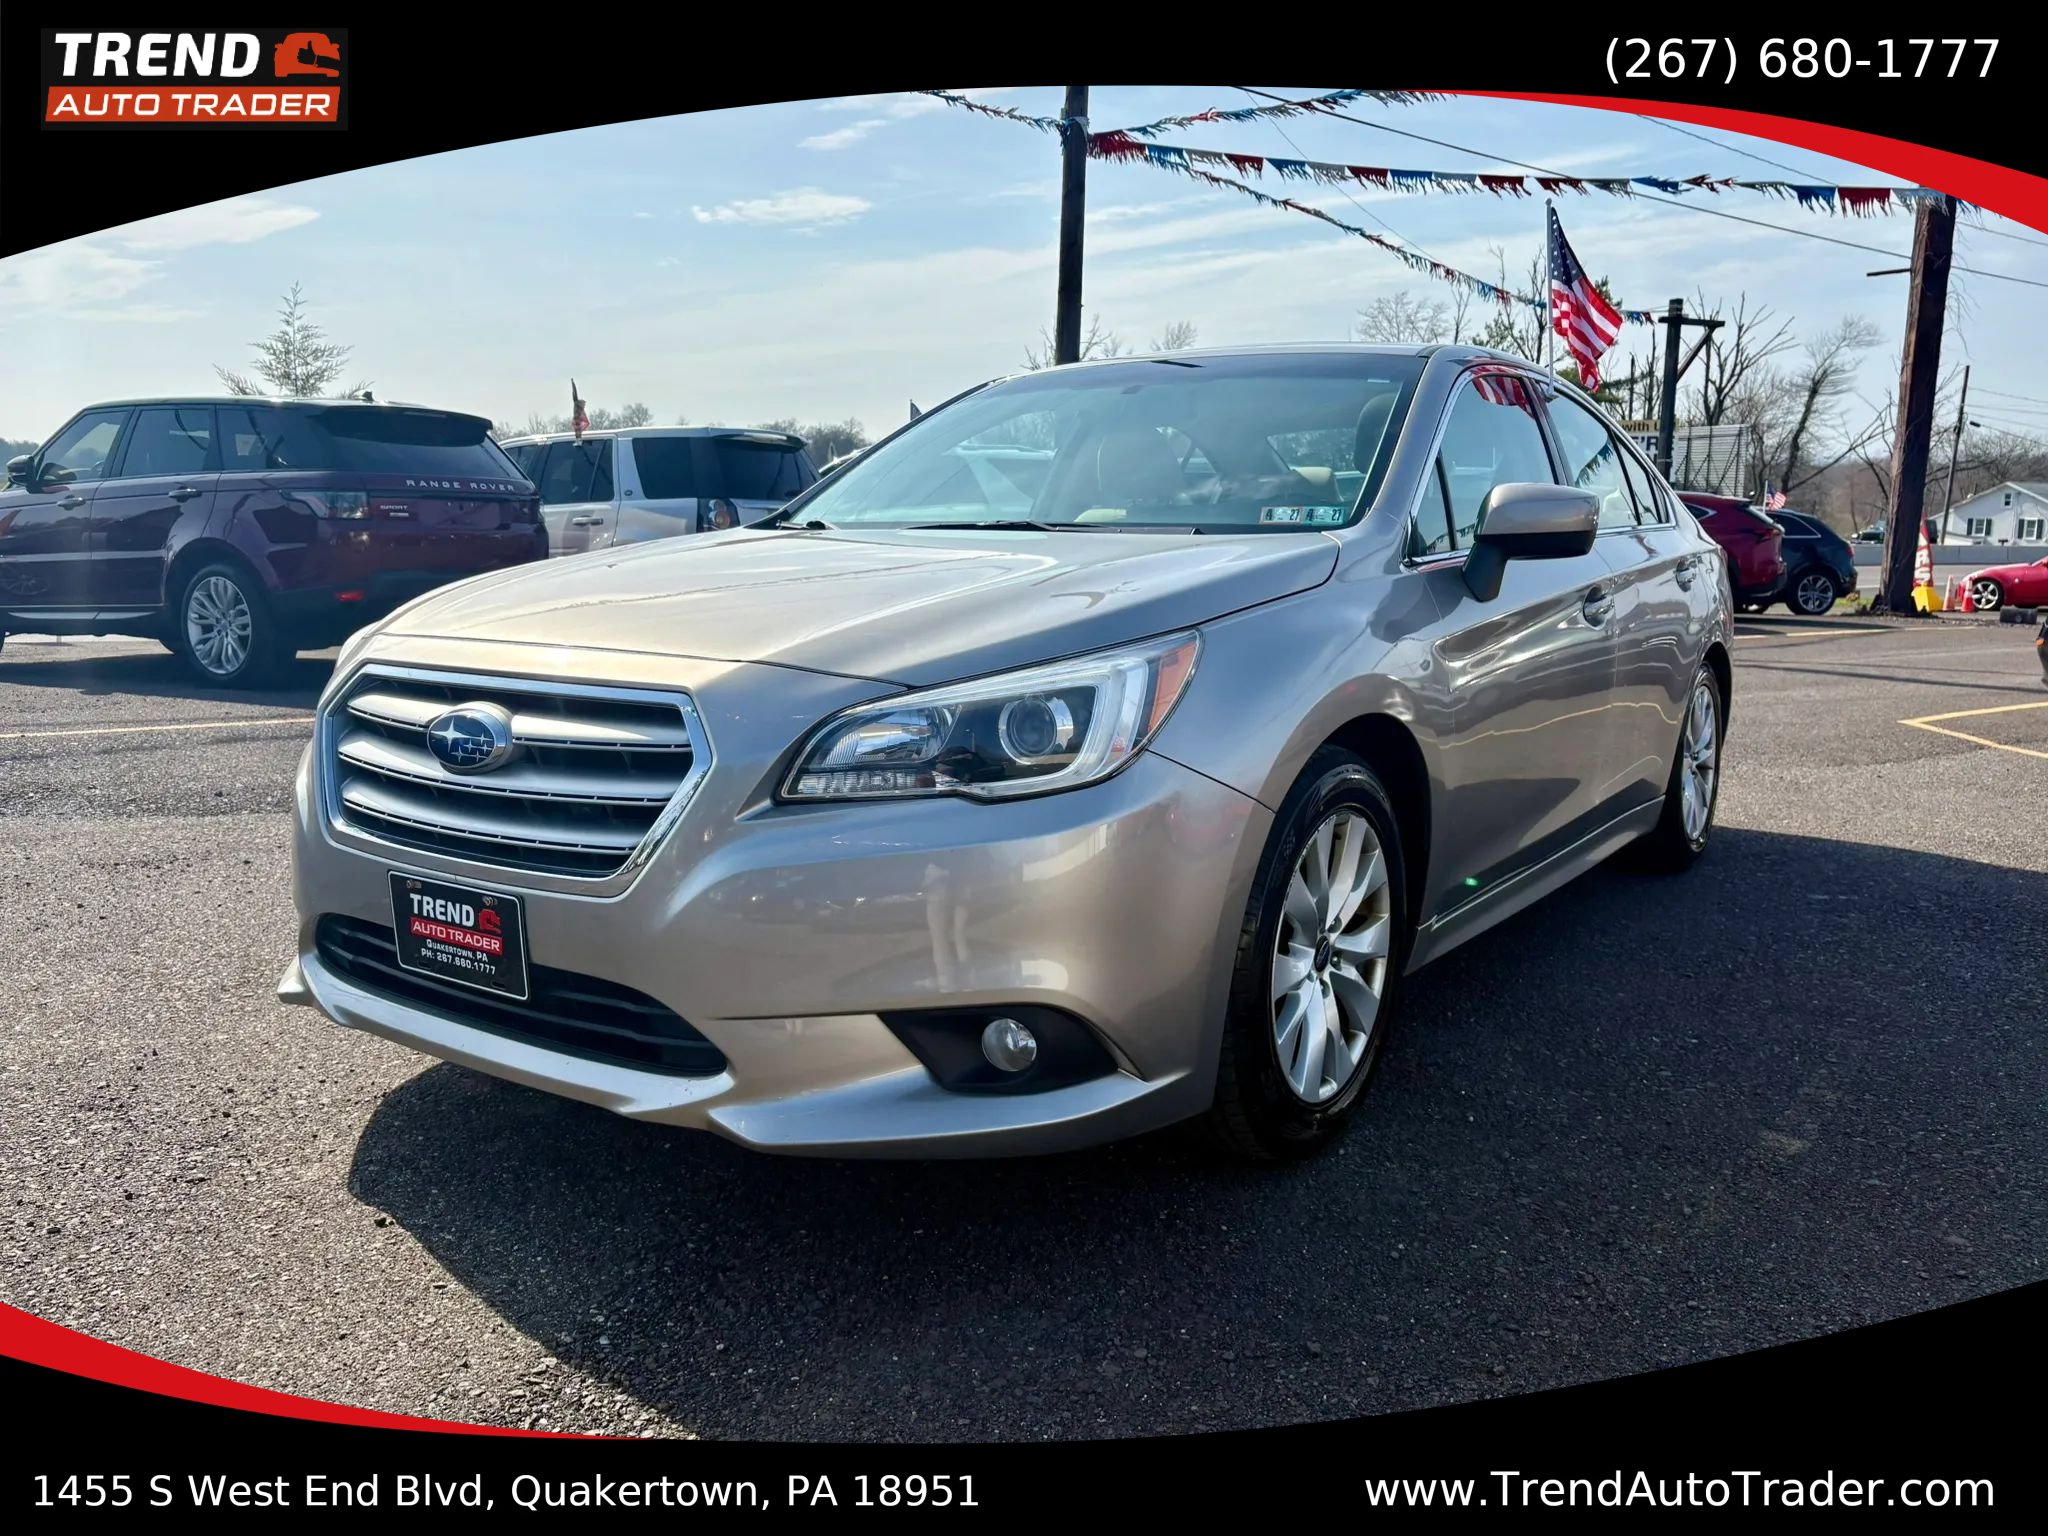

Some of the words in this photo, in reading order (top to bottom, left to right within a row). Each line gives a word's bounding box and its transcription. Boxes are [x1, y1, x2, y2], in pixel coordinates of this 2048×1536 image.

[406, 479, 461, 489] RANGE
[470, 482, 515, 492] ROVER
[409, 892, 475, 927] TREND
[412, 920, 446, 938] AUTO
[448, 928, 500, 952] TRADER
[476, 951, 489, 963] PA
